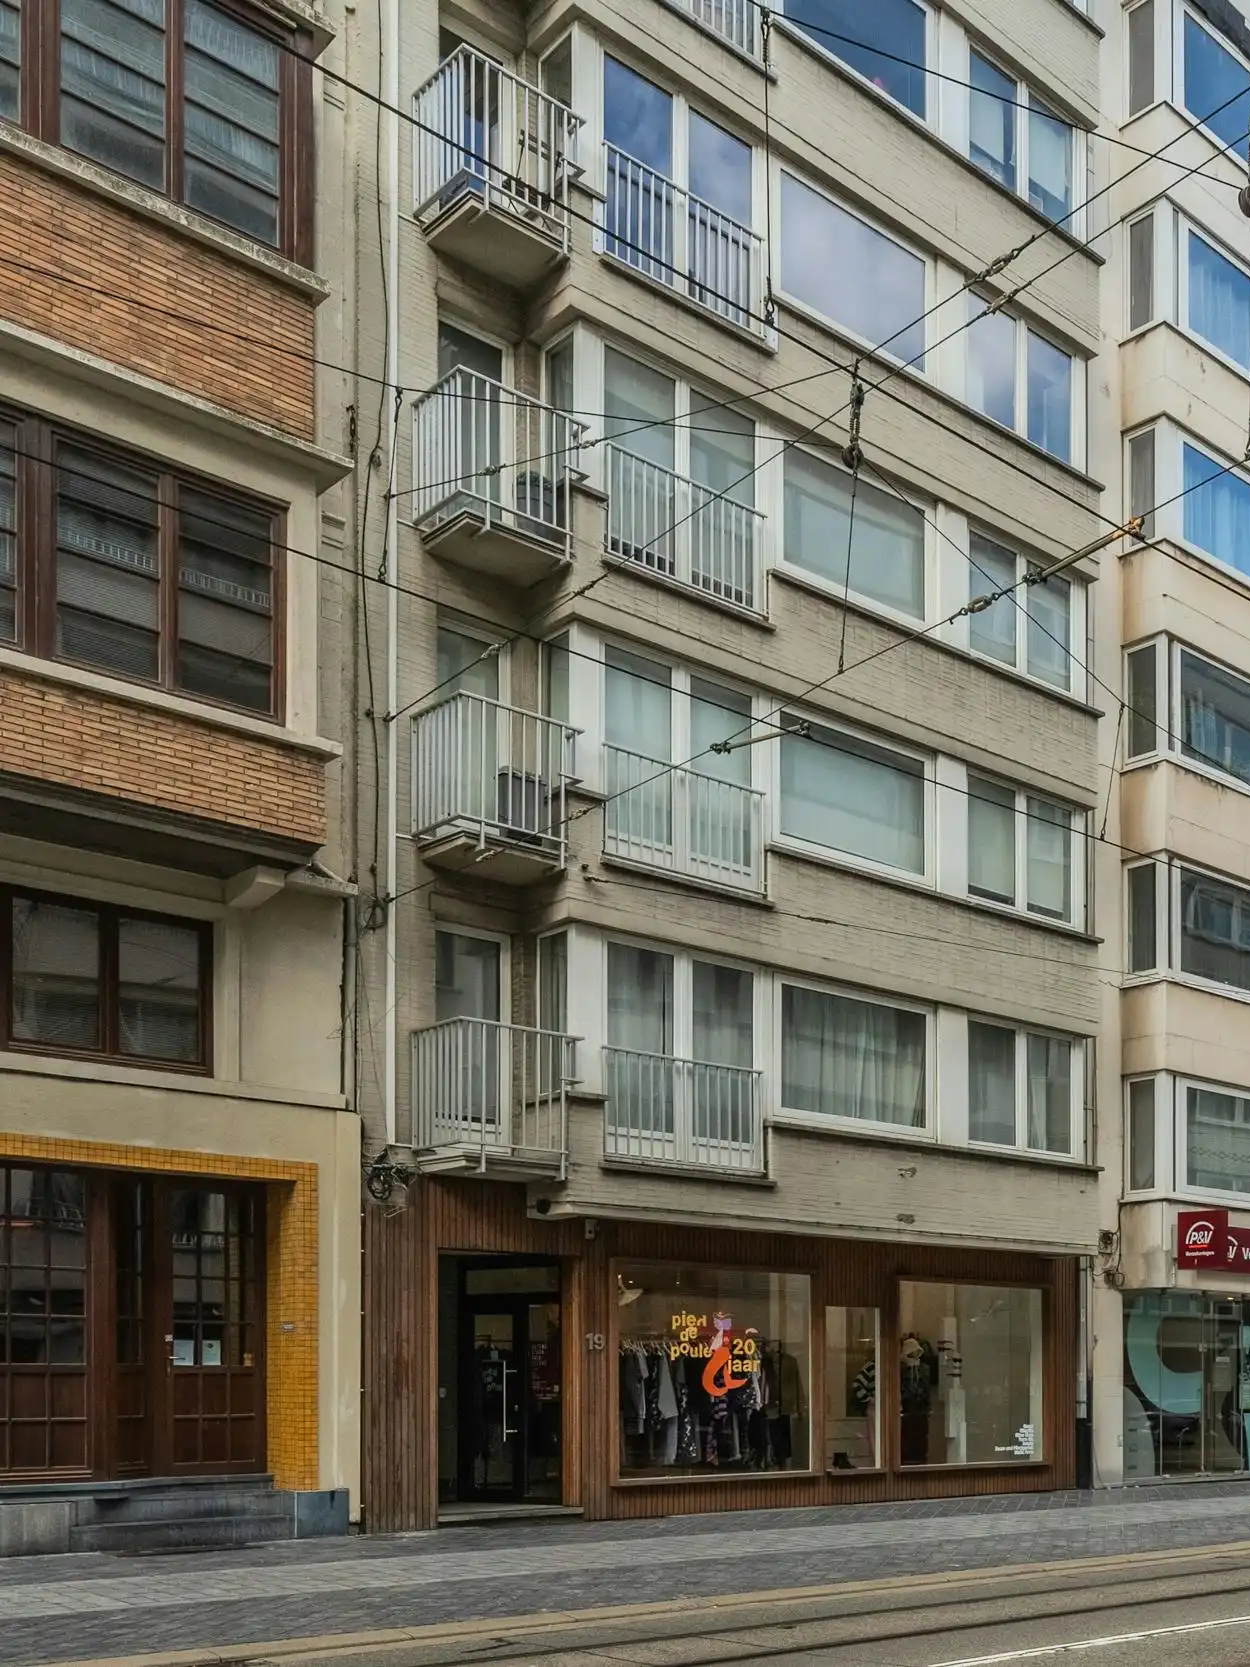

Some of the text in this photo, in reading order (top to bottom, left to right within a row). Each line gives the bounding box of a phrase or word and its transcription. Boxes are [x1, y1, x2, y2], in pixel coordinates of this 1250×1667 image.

[1189, 1231, 1213, 1245] P&V
[671, 1310, 707, 1329] pied
[586, 1333, 605, 1350] 19
[680, 1326, 698, 1342] de
[732, 1338, 756, 1355] 20
[727, 1354, 761, 1374] jaar
